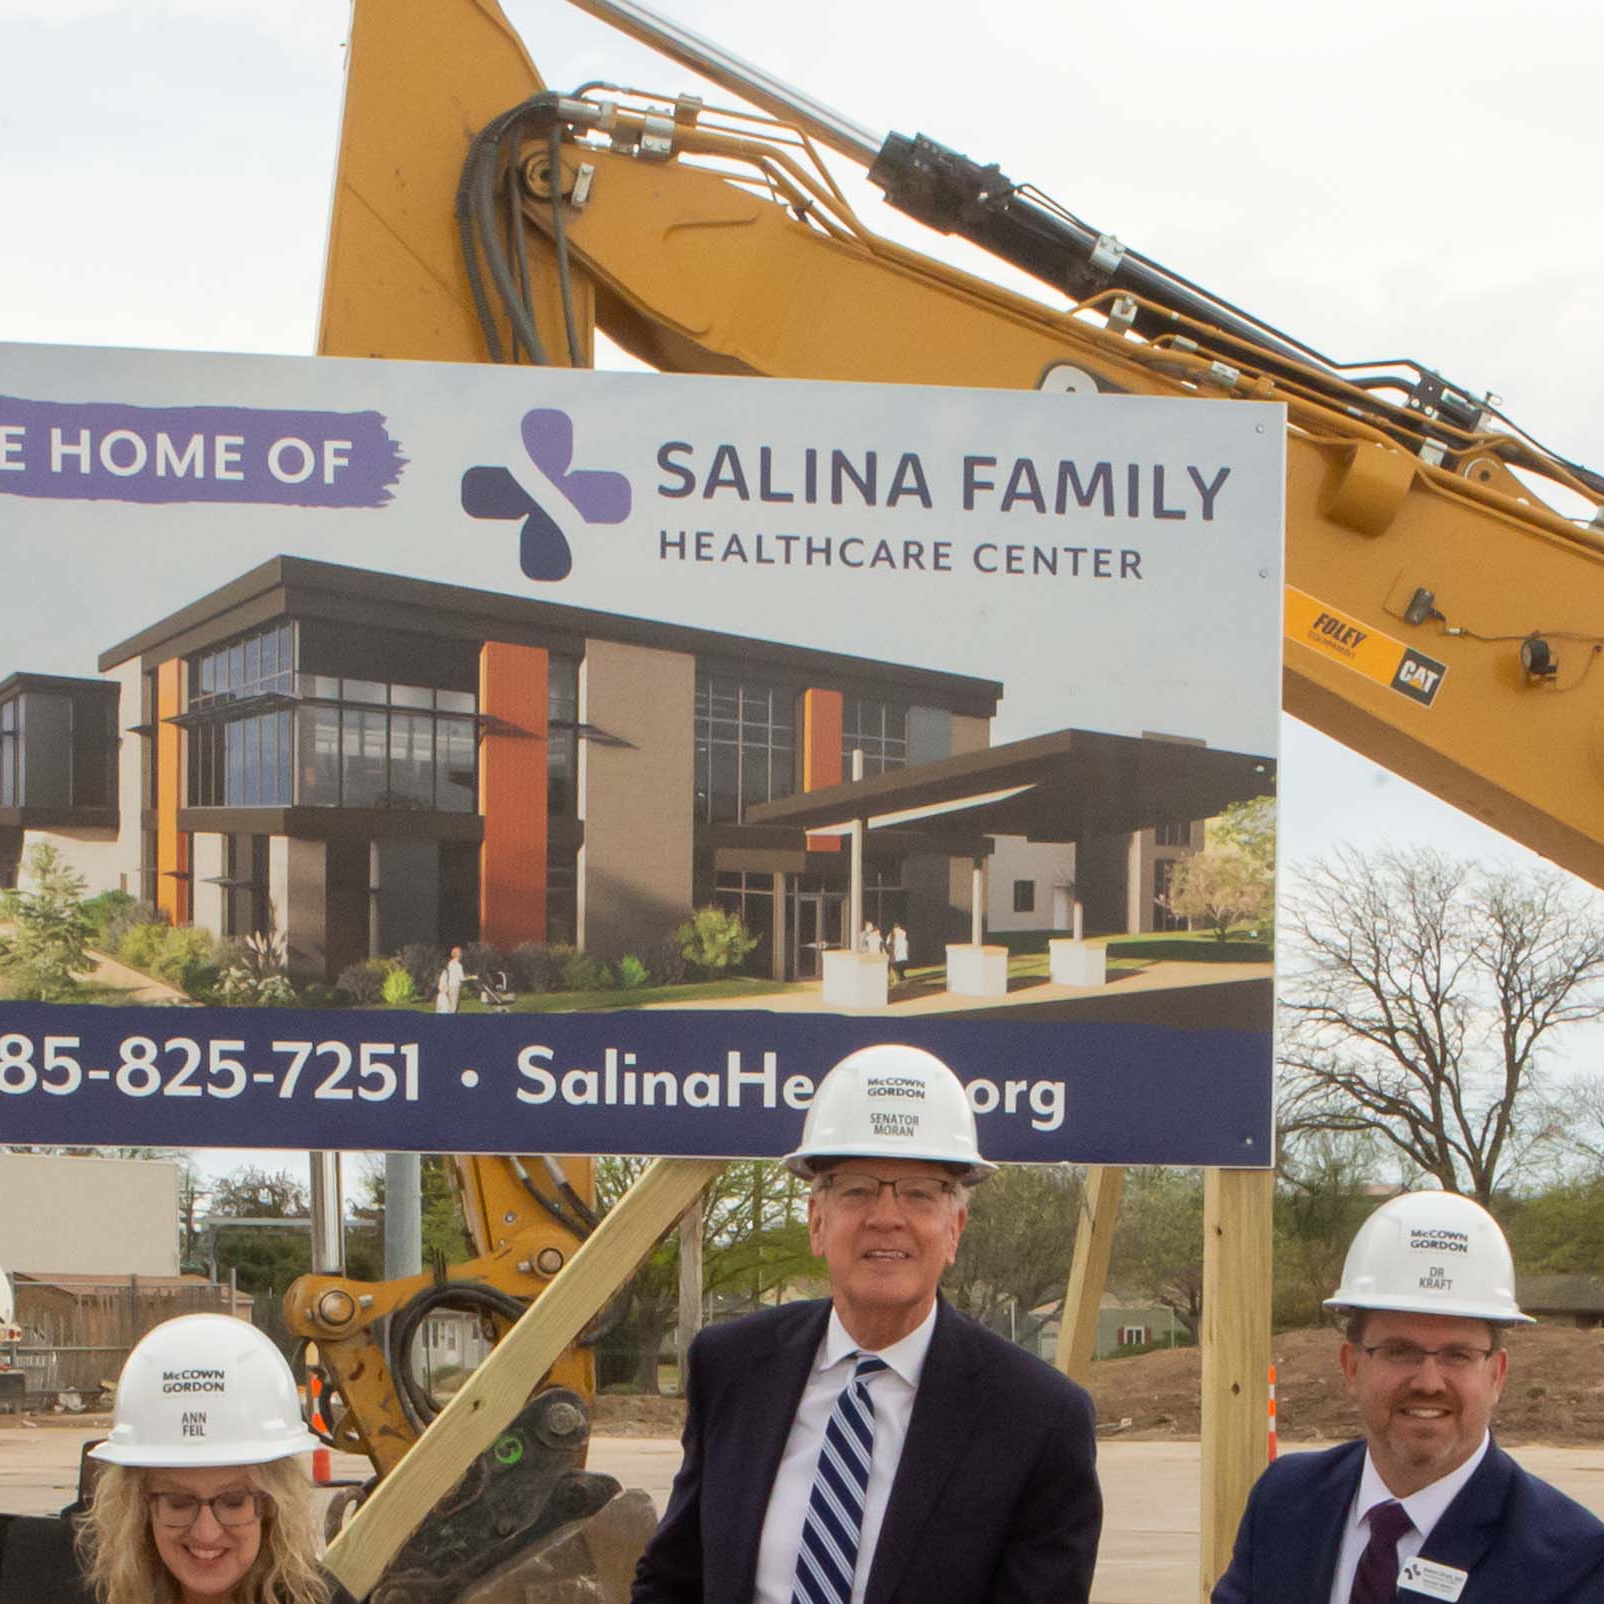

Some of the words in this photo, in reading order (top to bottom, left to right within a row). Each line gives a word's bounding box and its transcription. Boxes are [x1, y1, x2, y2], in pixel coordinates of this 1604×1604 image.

[50, 427, 245, 480] HOME
[267, 436, 353, 485] OF
[656, 440, 934, 509] SALINA
[961, 454, 1232, 521] FAMILY
[658, 529, 953, 572] HEALTHCARE
[972, 542, 1144, 580] CENTER
[1311, 611, 1367, 649] FOLEY
[1399, 659, 1439, 694] CAT
[515, 1044, 1066, 1132] SalinaHeorg
[867, 1076, 926, 1089] McCOWN
[867, 1087, 926, 1100] GORDON
[869, 1112, 920, 1126] SENATOR
[873, 1123, 915, 1137] MORAN
[1410, 1229, 1468, 1242] McCOWN
[1409, 1239, 1468, 1254] GORDON
[1429, 1266, 1445, 1277] DR
[1418, 1277, 1454, 1291] KRAFT
[162, 1369, 225, 1381] McCOWN
[162, 1381, 225, 1394] GORDON
[181, 1411, 207, 1425] ANN
[182, 1424, 206, 1437] FEIL
